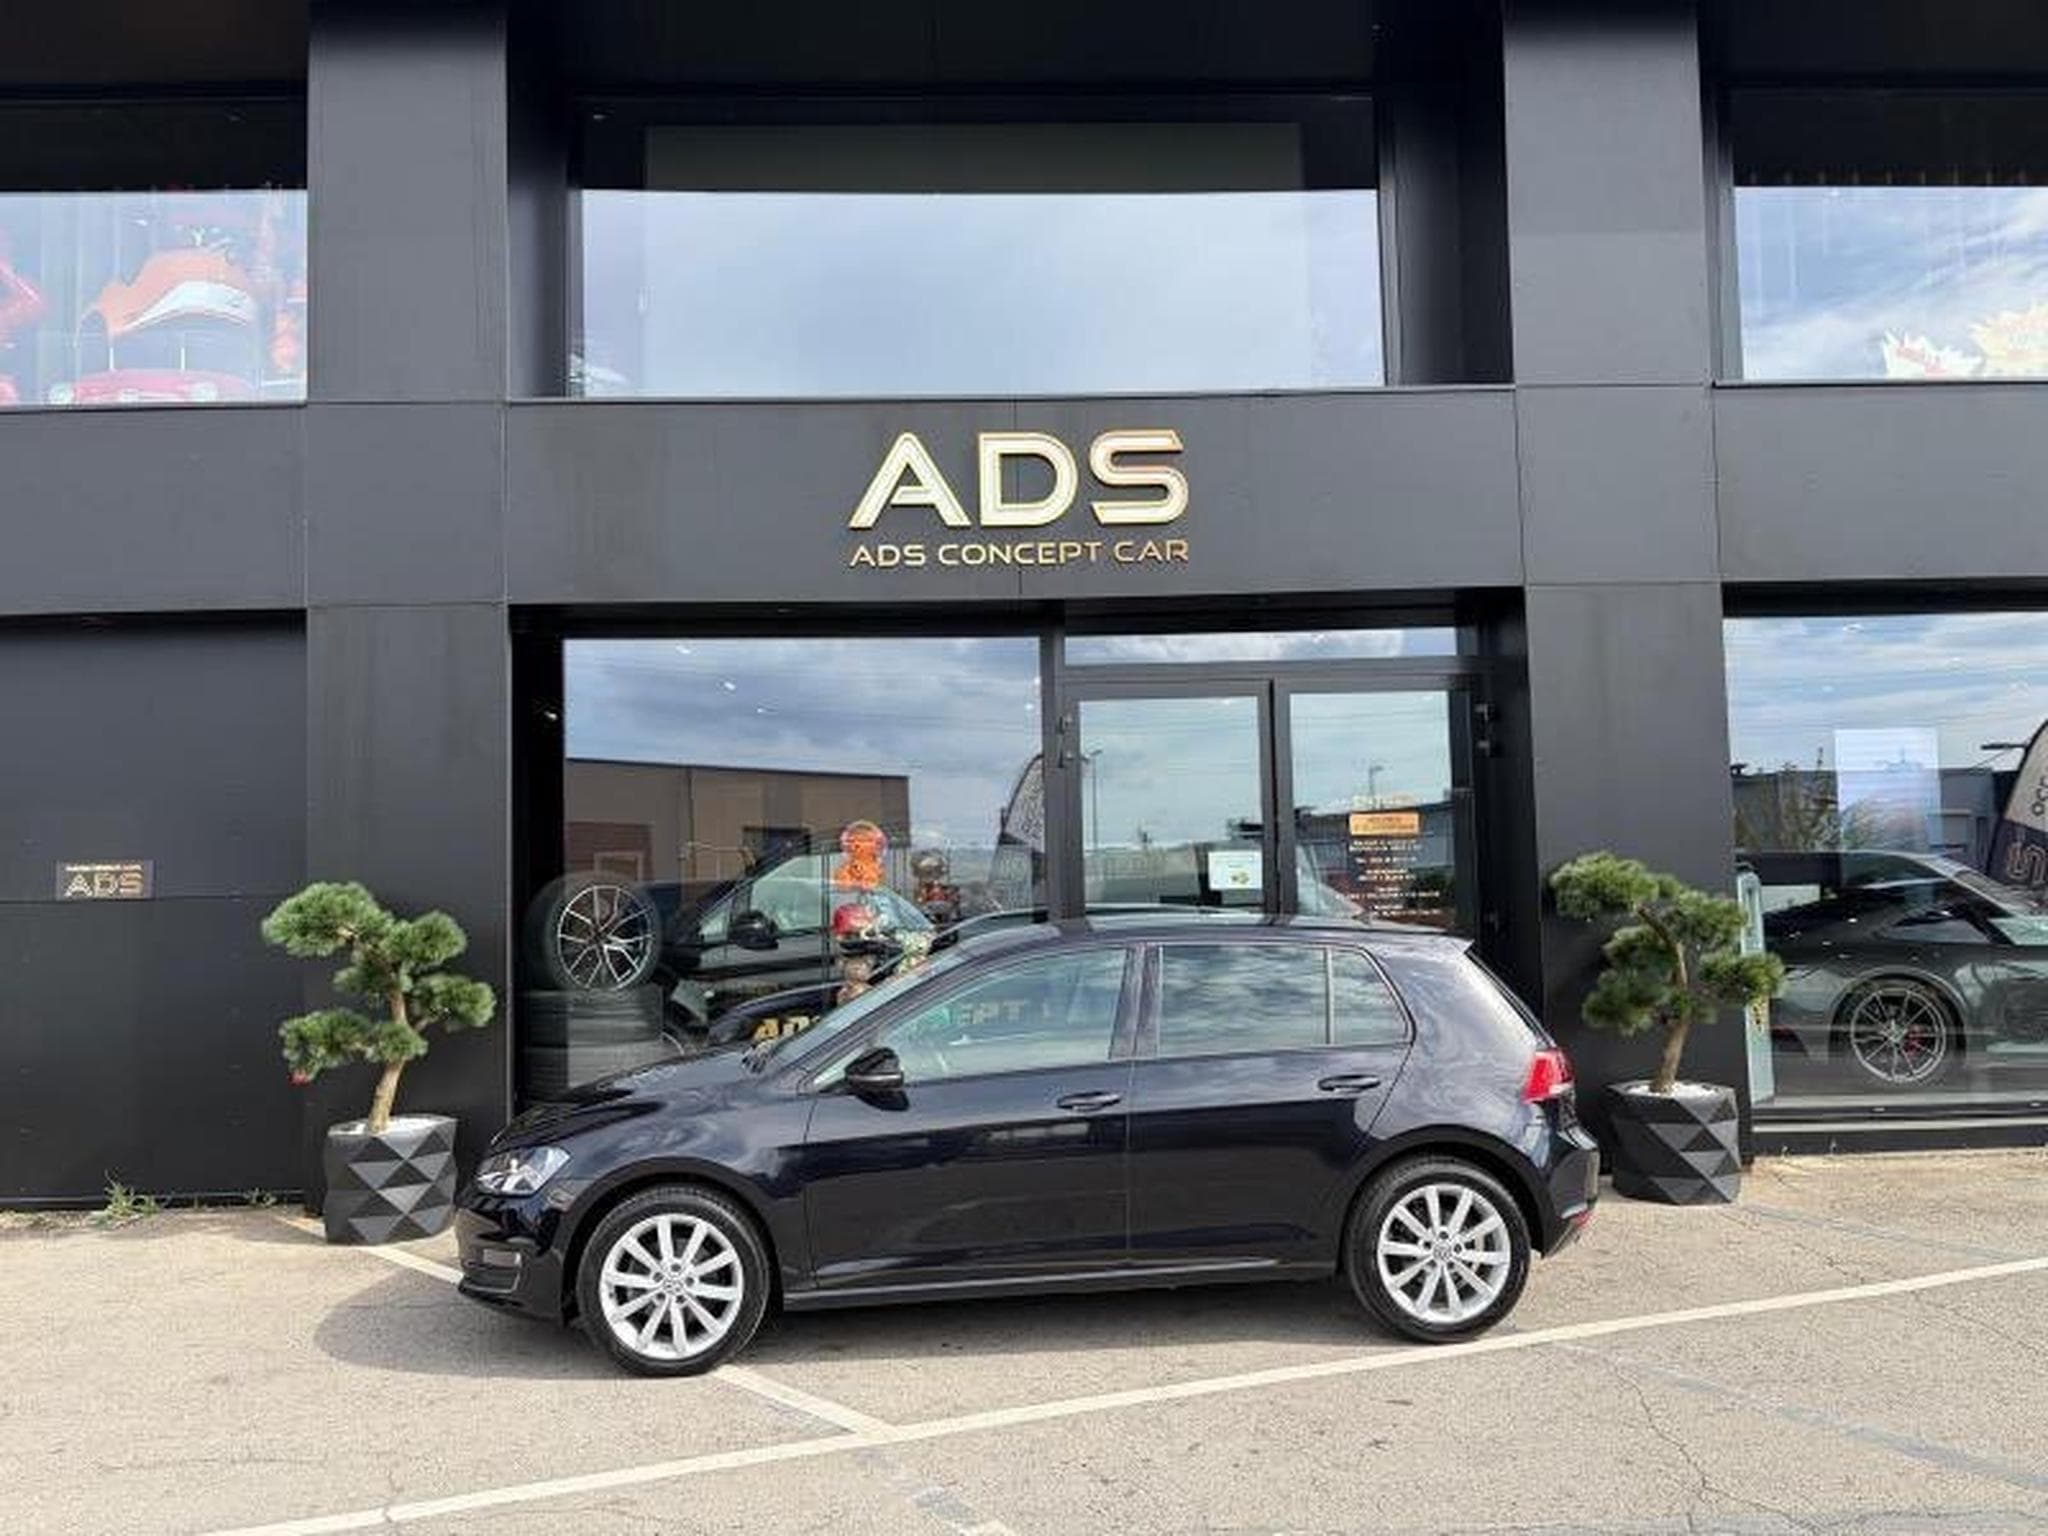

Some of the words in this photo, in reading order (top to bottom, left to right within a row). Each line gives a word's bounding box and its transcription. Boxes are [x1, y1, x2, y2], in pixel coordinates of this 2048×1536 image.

[849, 429, 1189, 528] ADS
[849, 544, 926, 568] ADS
[938, 541, 1102, 566] CONCEPT
[1114, 539, 1189, 563] CAR
[64, 873, 144, 897] ADS
